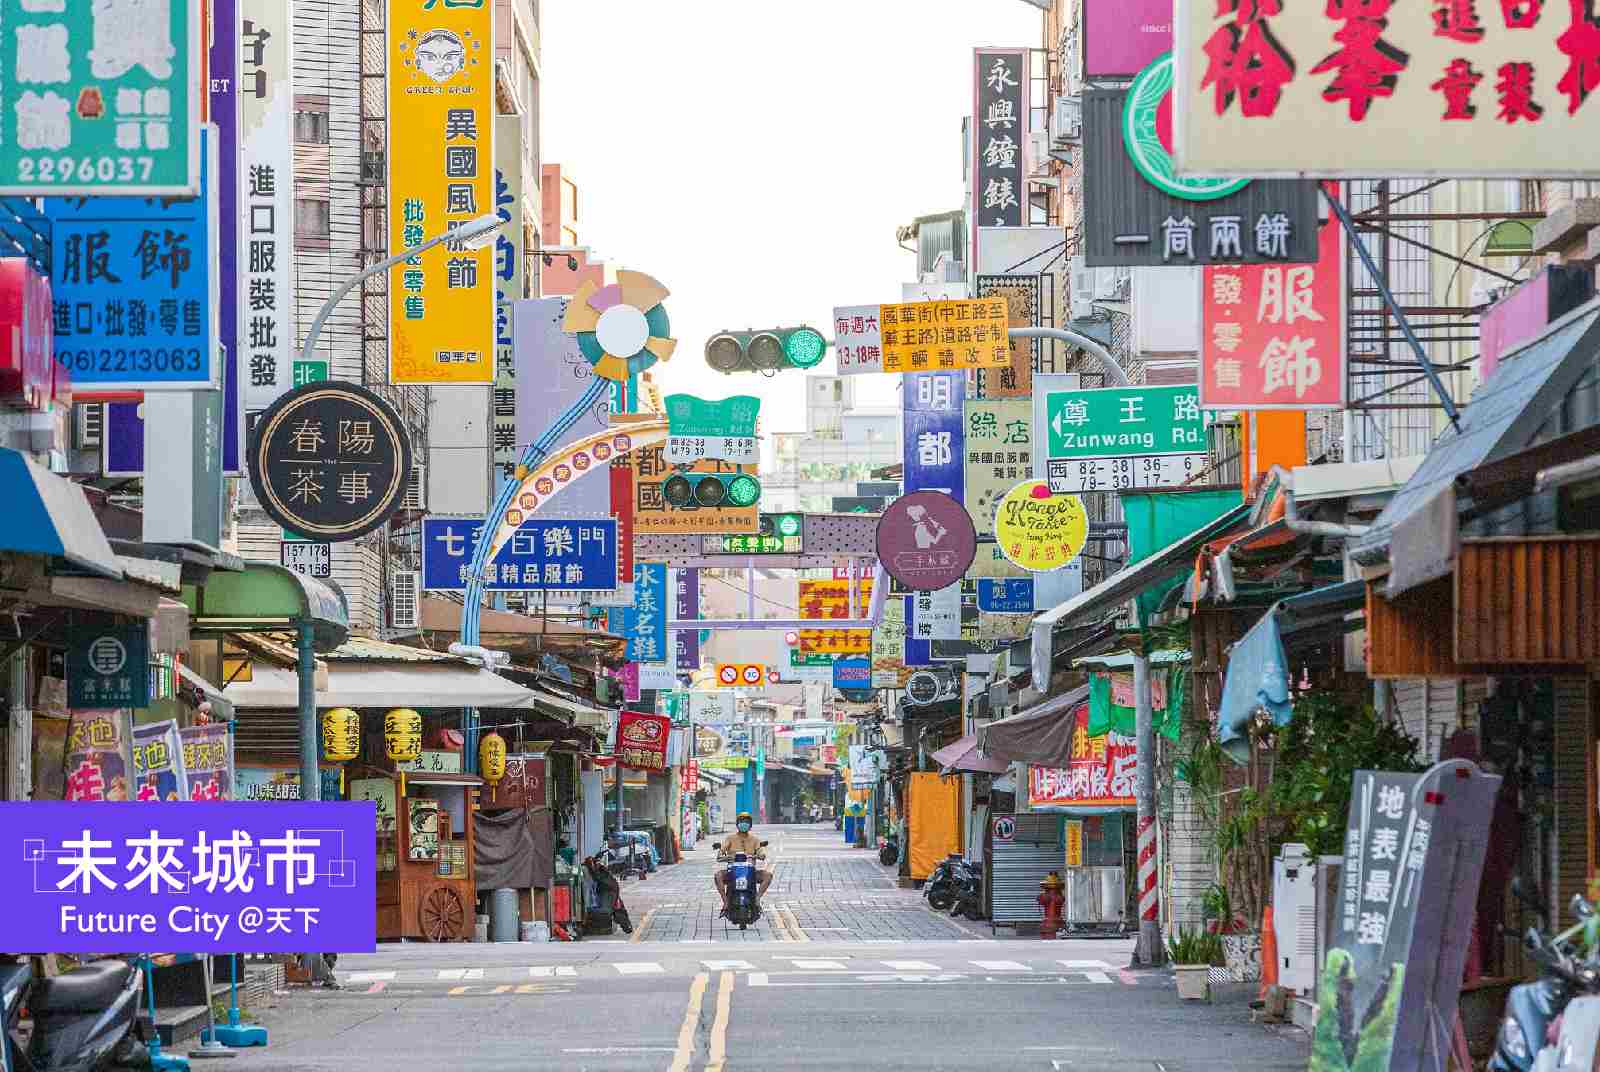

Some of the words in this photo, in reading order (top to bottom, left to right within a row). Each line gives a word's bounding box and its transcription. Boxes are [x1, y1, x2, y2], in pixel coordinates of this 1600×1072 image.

[983, 58, 1019, 226] 永興鐘錶
[18, 157, 155, 183] 2296037
[1114, 213, 1291, 261] 一筒兩餅
[61, 229, 192, 289] 服飾
[249, 165, 278, 387] 進口服裝批發
[836, 315, 878, 336] 每週六
[883, 303, 1005, 325] 國華街(中正路至
[1212, 264, 1244, 389] 發·零售
[1257, 266, 1327, 398] 服飾
[838, 344, 880, 365] 13-18時
[294, 365, 316, 386] 北
[1063, 394, 1201, 427] 尊王路
[289, 419, 376, 456] 春陽
[917, 374, 952, 491] 明都
[1063, 432, 1155, 449] Zunwang
[1172, 428, 1204, 443] Rd.
[288, 469, 374, 504] 茶事
[1051, 462, 1067, 478] 西
[309, 544, 329, 557] 178
[309, 563, 328, 575] 156
[1357, 784, 1406, 945] 地表最強
